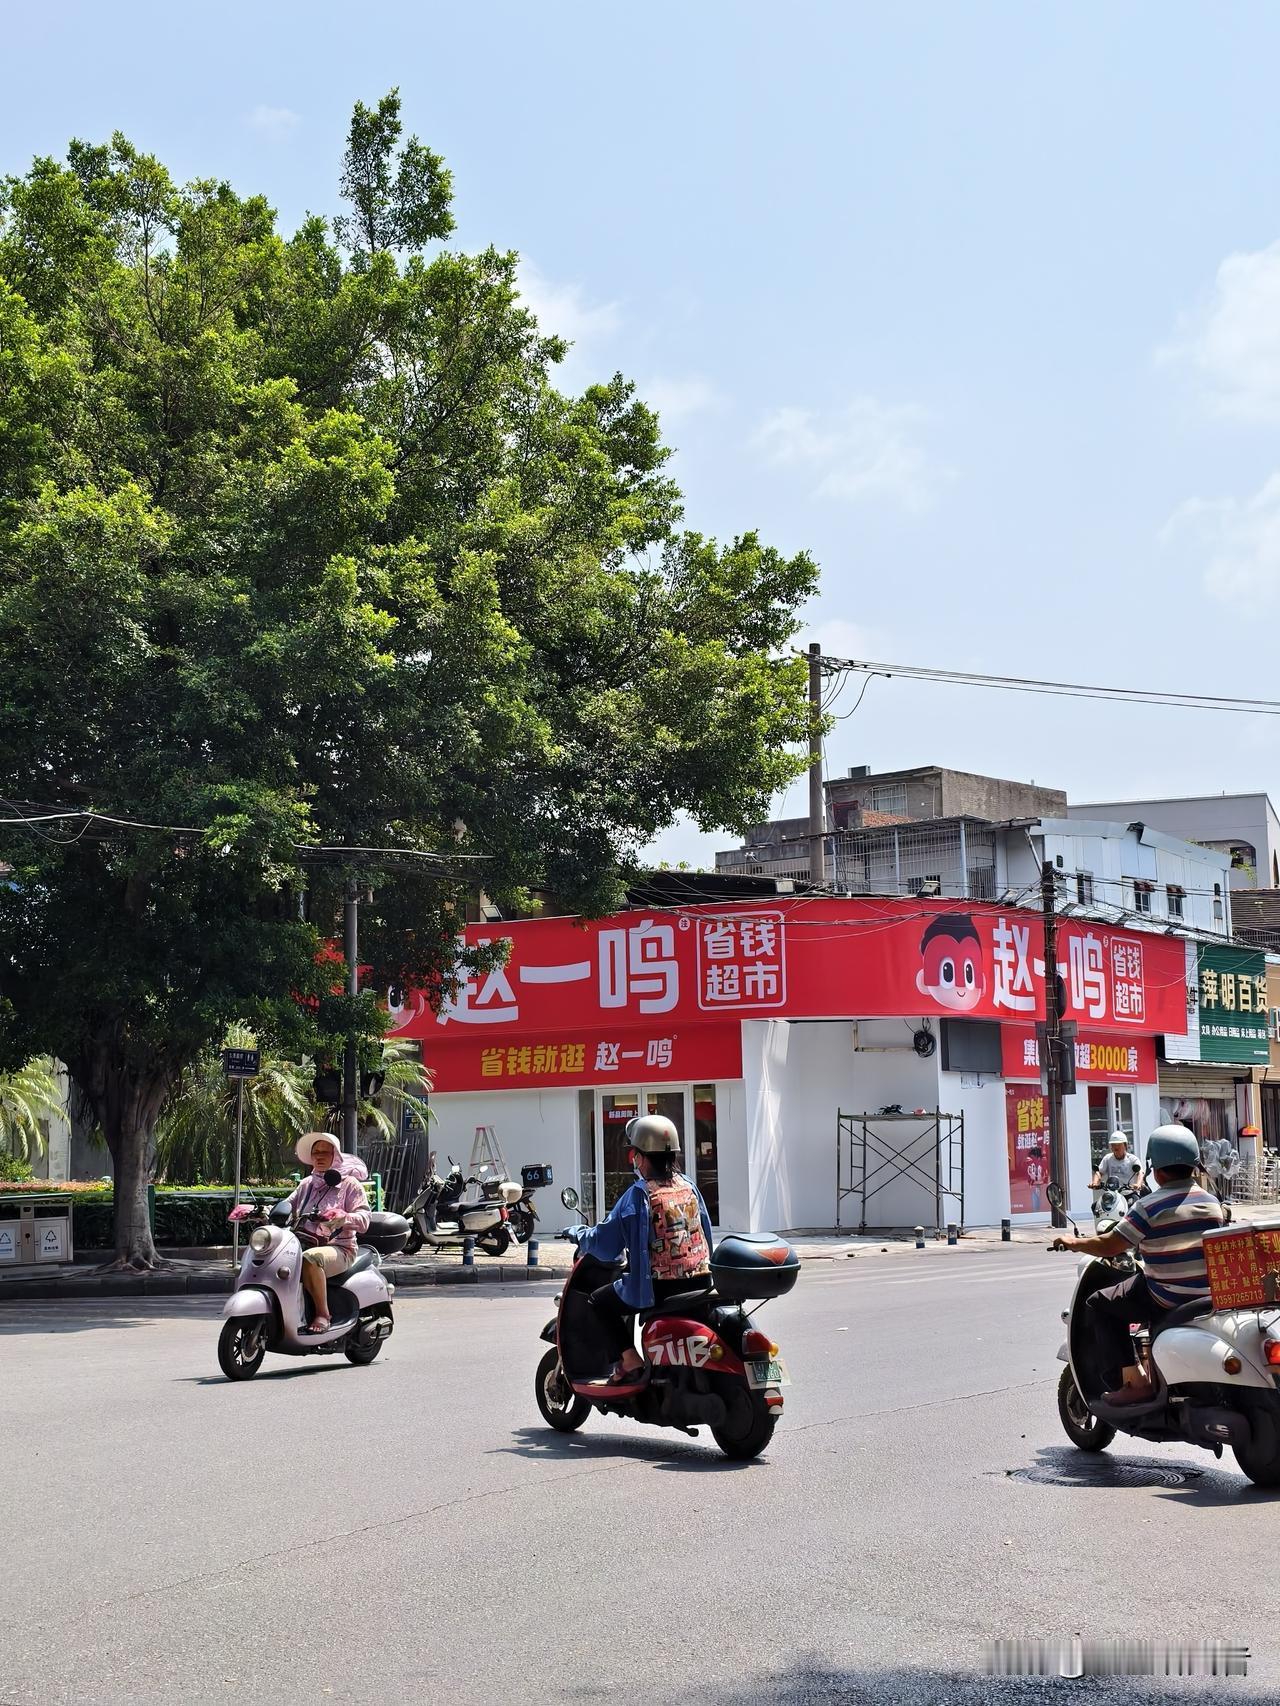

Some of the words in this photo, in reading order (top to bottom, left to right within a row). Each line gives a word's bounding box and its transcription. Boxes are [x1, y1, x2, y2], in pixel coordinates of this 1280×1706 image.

[704, 919, 776, 959] 省钱
[436, 918, 679, 1025] 赵一鸣
[706, 961, 779, 1001] 超市
[993, 917, 1106, 1019] 赵一鸣
[1113, 944, 1141, 979] 省钱
[1115, 981, 1143, 1015] 超市
[480, 1043, 586, 1077] 省钱就逛
[594, 1038, 673, 1072] 赵一鸣
[1016, 1096, 1044, 1132] 省钱
